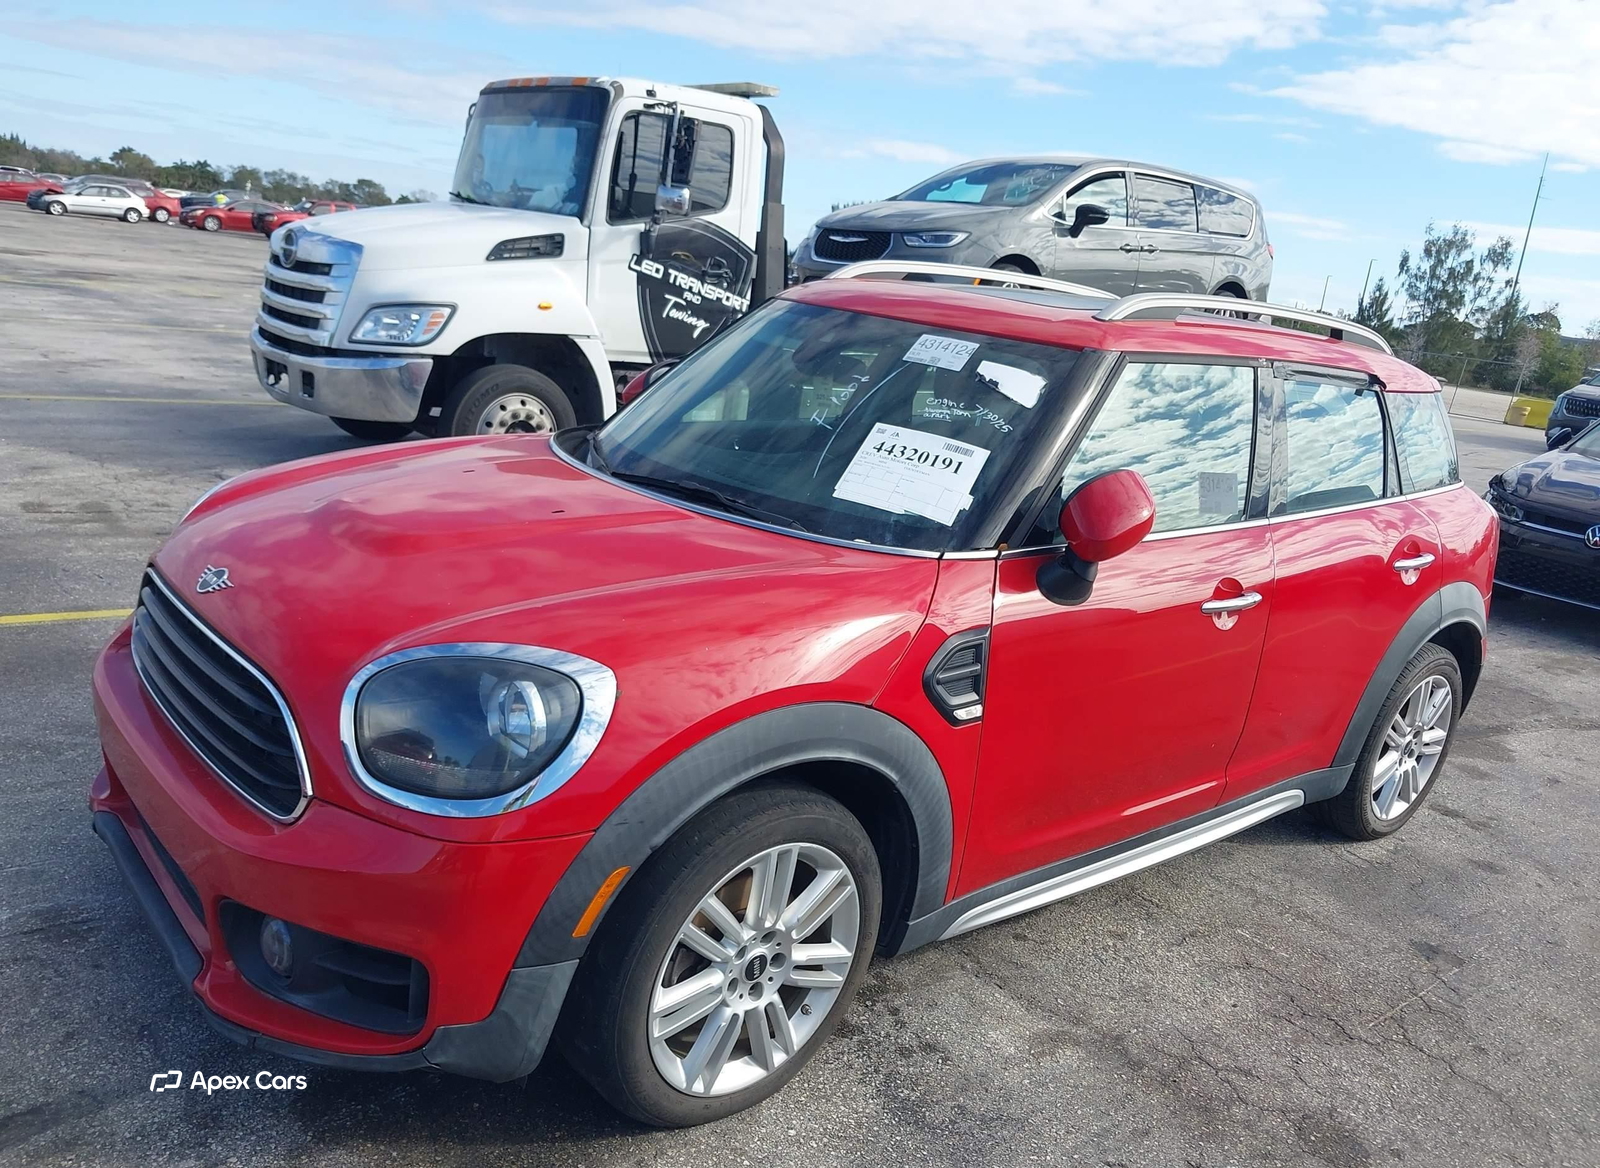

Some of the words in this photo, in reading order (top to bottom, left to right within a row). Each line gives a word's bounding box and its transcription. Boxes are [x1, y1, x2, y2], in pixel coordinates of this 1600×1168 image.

[667, 269, 751, 312] TRANSPORT
[683, 291, 702, 305] AND
[662, 294, 710, 339] Towing
[918, 338, 976, 358] 4314124
[926, 397, 965, 408] engine
[872, 440, 964, 475] 44320191
